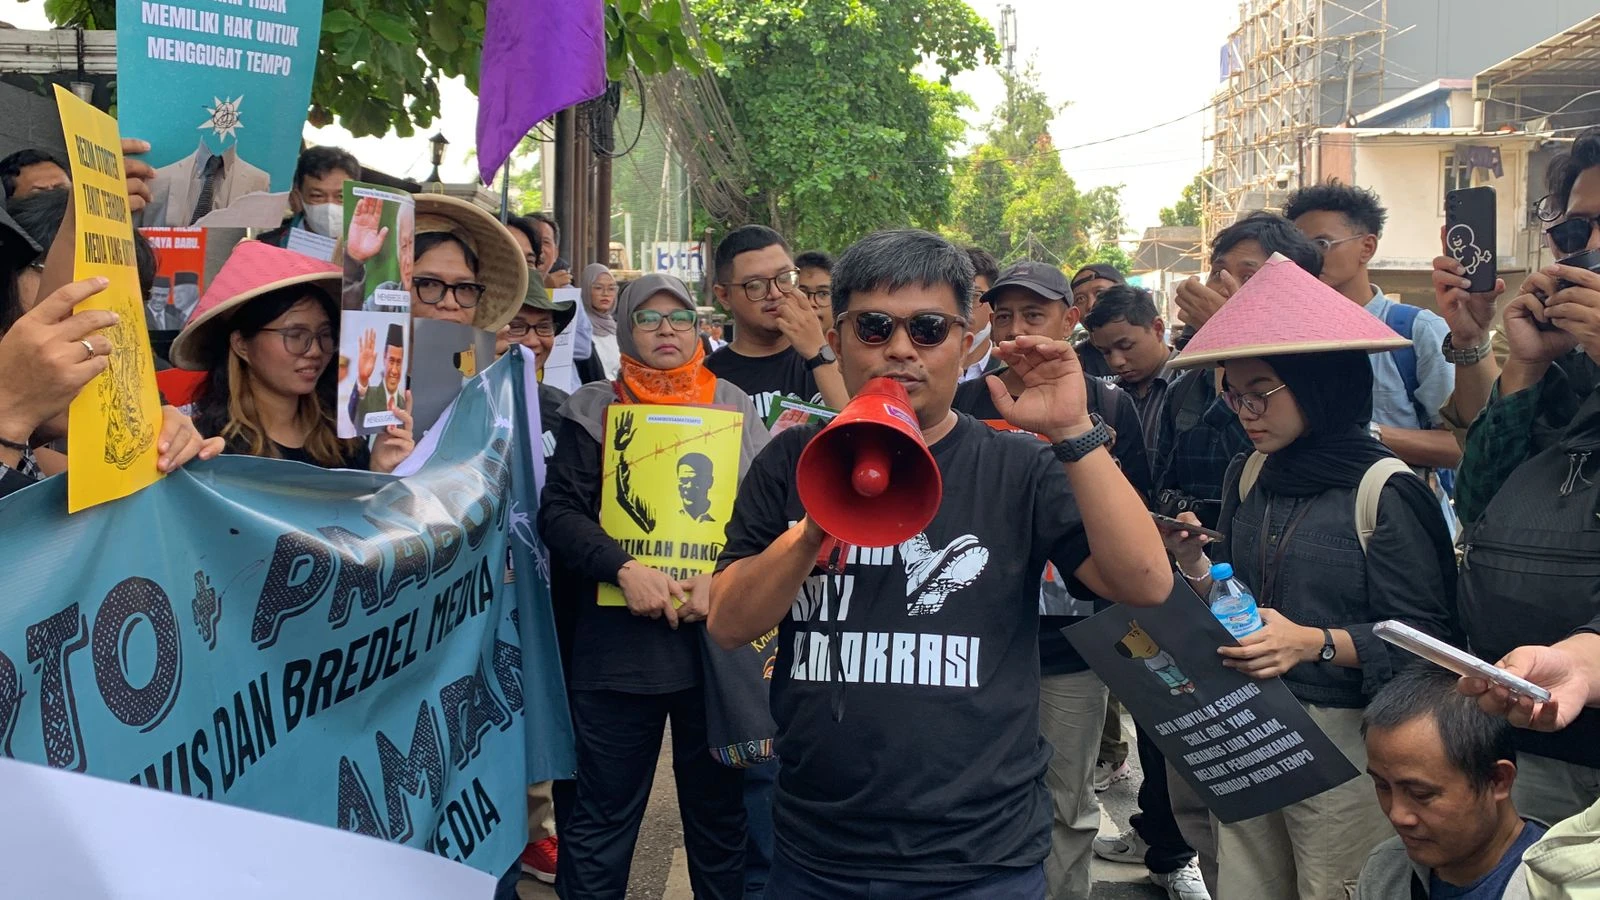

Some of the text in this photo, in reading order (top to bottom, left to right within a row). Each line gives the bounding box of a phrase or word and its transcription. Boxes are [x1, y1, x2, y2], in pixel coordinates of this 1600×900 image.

[142, 1, 300, 47] MEMILIKI HAK UNTUK
[147, 36, 292, 77] MENGGUGAT TEMPO
[680, 542, 719, 561] DAKU
[0, 576, 183, 774] TO
[212, 671, 277, 794] DAN
[282, 607, 420, 734] BREDEL
[425, 554, 495, 654] MEDIA
[790, 630, 981, 688] MOKRASI
[1154, 720, 1179, 736] SAYA
[1214, 682, 1262, 713] SEORANG
[1228, 708, 1257, 730] YANG
[1182, 717, 1288, 767] MENANGIS LUAR DALAM,
[1193, 730, 1305, 782] MELIHAT PEMBUNGKAMAN
[1208, 748, 1315, 797] TERHADAP MEDIA TEMPO
